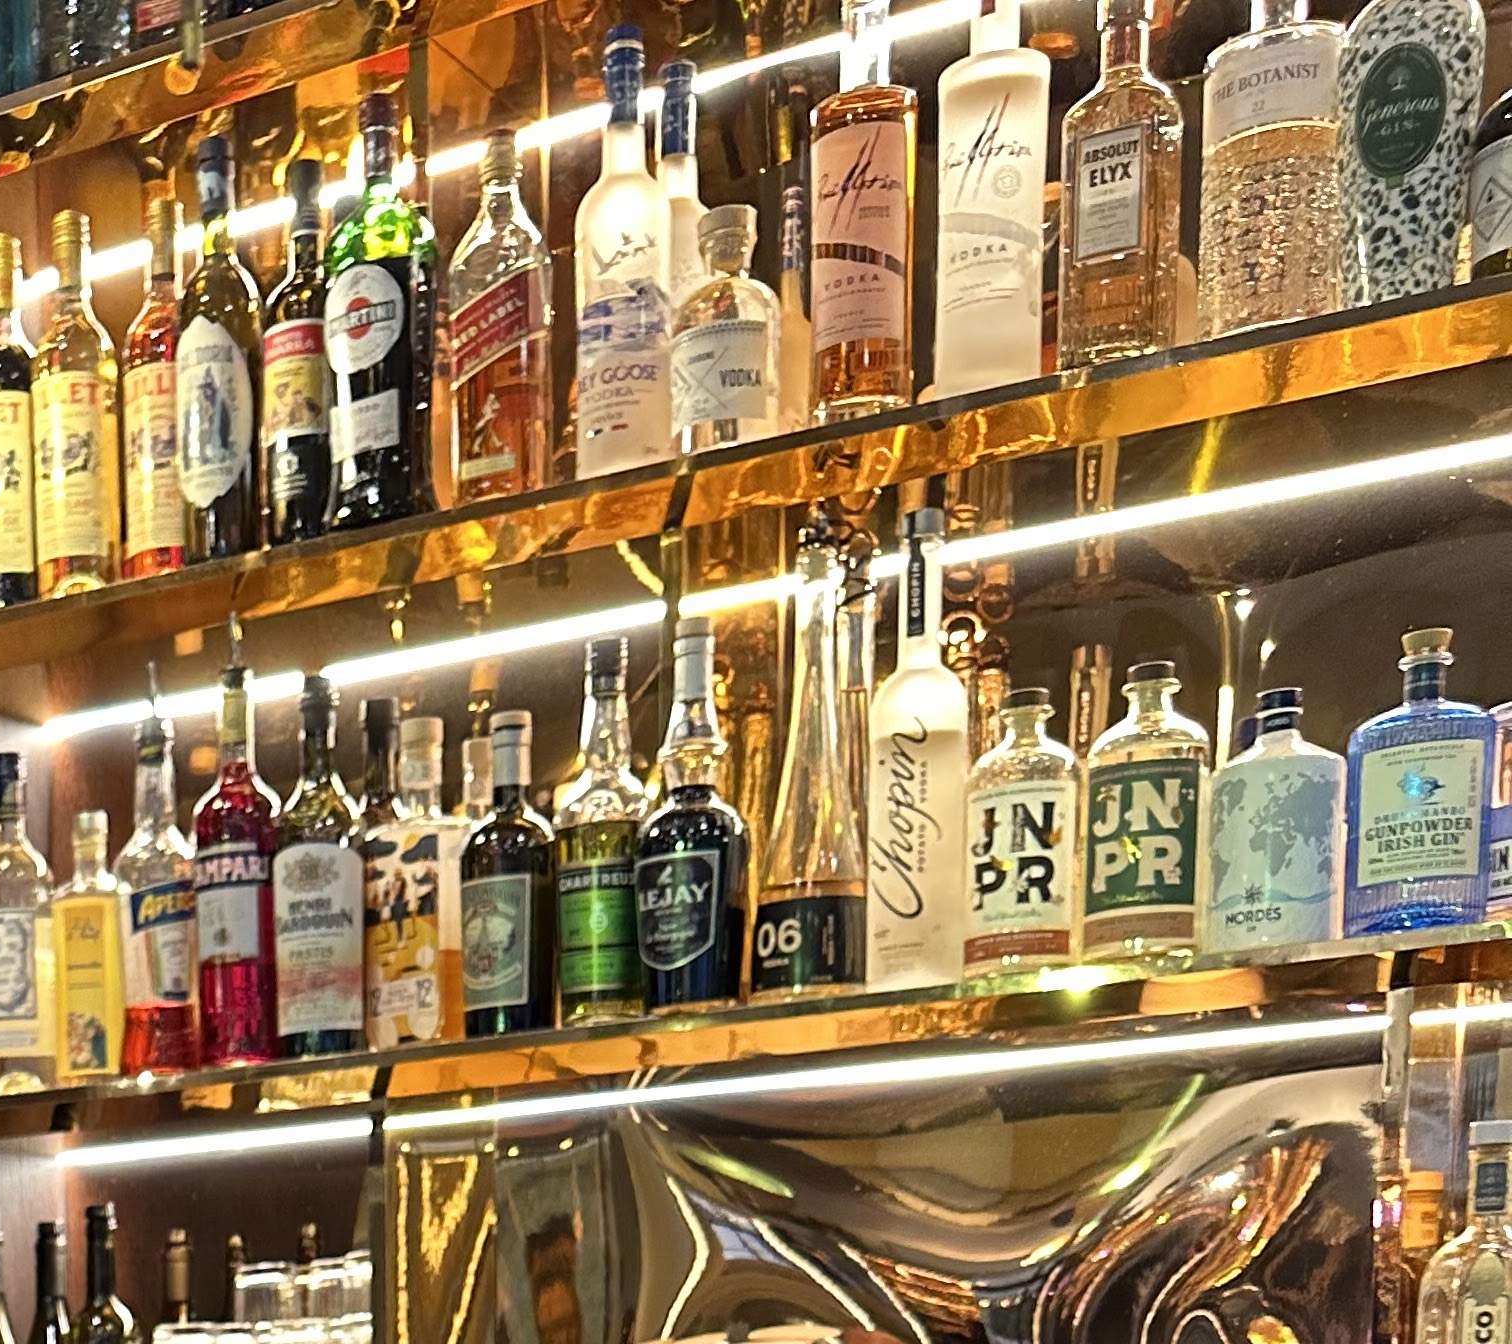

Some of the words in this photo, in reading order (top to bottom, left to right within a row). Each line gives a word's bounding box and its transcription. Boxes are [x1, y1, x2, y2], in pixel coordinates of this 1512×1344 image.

[1214, 80, 1235, 103] THE
[1238, 63, 1321, 90] BOTANIST
[1360, 97, 1439, 138] Generous
[1084, 140, 1139, 164] ABSOLUT
[1089, 160, 1132, 188] ELYX
[579, 373, 598, 393] EY
[601, 363, 658, 386] GOOSE
[719, 369, 761, 387] VODKA
[871, 717, 941, 919] Chopin
[1365, 817, 1473, 841] GUNPOWDER
[1377, 834, 1425, 853] IRISH
[1431, 833, 1461, 846] GIN
[193, 856, 268, 889] AMPARI
[559, 871, 635, 892] CHARREUS
[639, 881, 711, 912] LEJAY
[757, 918, 802, 957] 06
